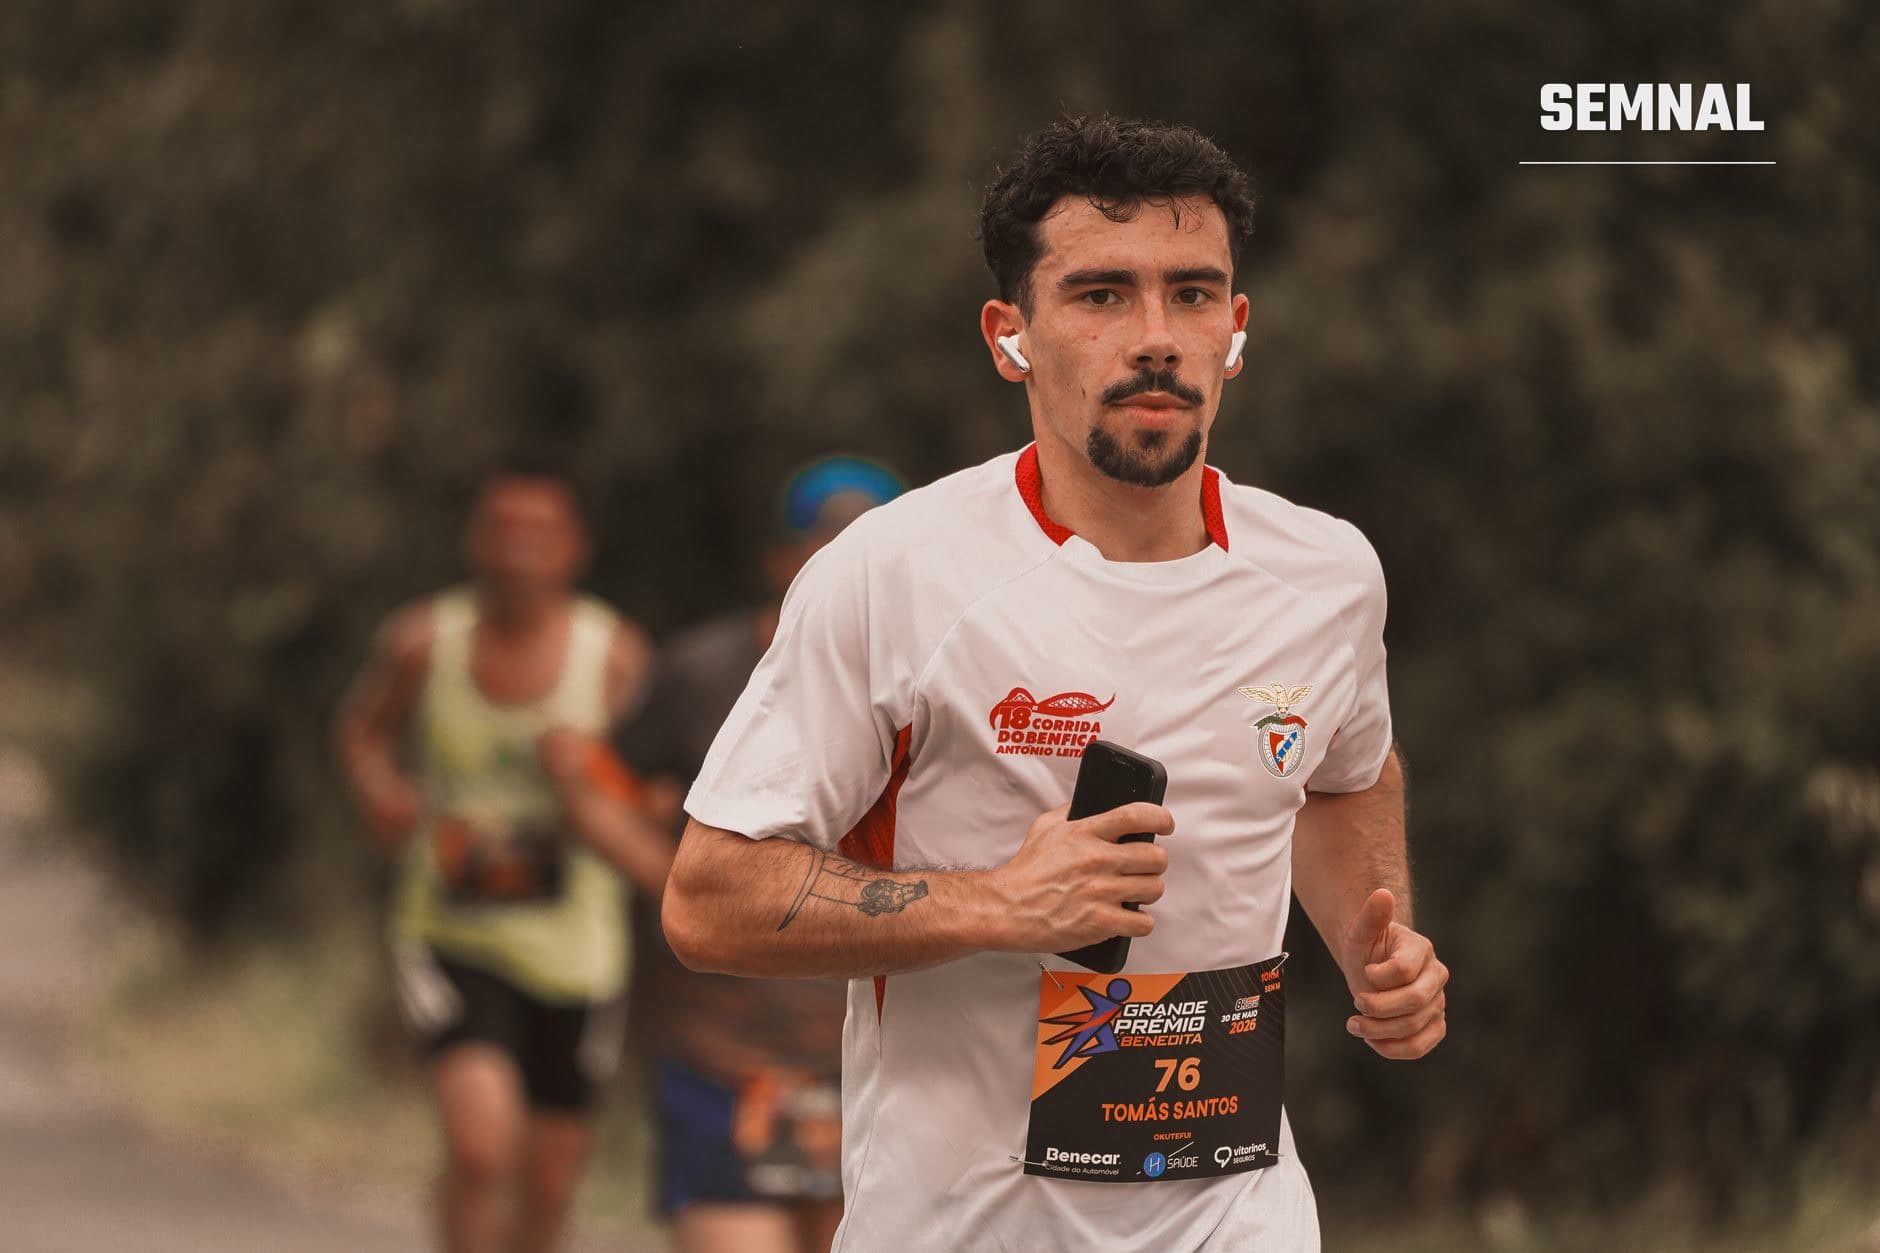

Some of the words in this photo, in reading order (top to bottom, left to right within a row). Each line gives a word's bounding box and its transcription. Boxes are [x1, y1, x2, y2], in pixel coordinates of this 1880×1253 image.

[999, 706, 1032, 730] 18
[1032, 718, 1101, 733] CORRIDA
[996, 745, 1053, 756] ANTÓNIO
[1123, 1000, 1209, 1017] GRANDE
[1221, 1015, 1231, 1023] 30
[1231, 1012, 1242, 1021] DE
[1242, 1009, 1258, 1019] MAIO
[1113, 1013, 1206, 1034] PRÉMIO
[1229, 1018, 1257, 1035] 2026
[1120, 1033, 1203, 1047] BENEDITA
[1154, 1057, 1201, 1093] 76
[1102, 1097, 1168, 1122] TOMÁS
[1173, 1095, 1239, 1120] SANTOS
[1233, 1142, 1267, 1157] vitorinos
[1167, 1155, 1200, 1170] SAÚDE
[1233, 1154, 1256, 1165] SEGUROS
[1046, 1164, 1071, 1173] Cidade
[1071, 1165, 1081, 1173] do
[1082, 1166, 1120, 1176] Automóvel
